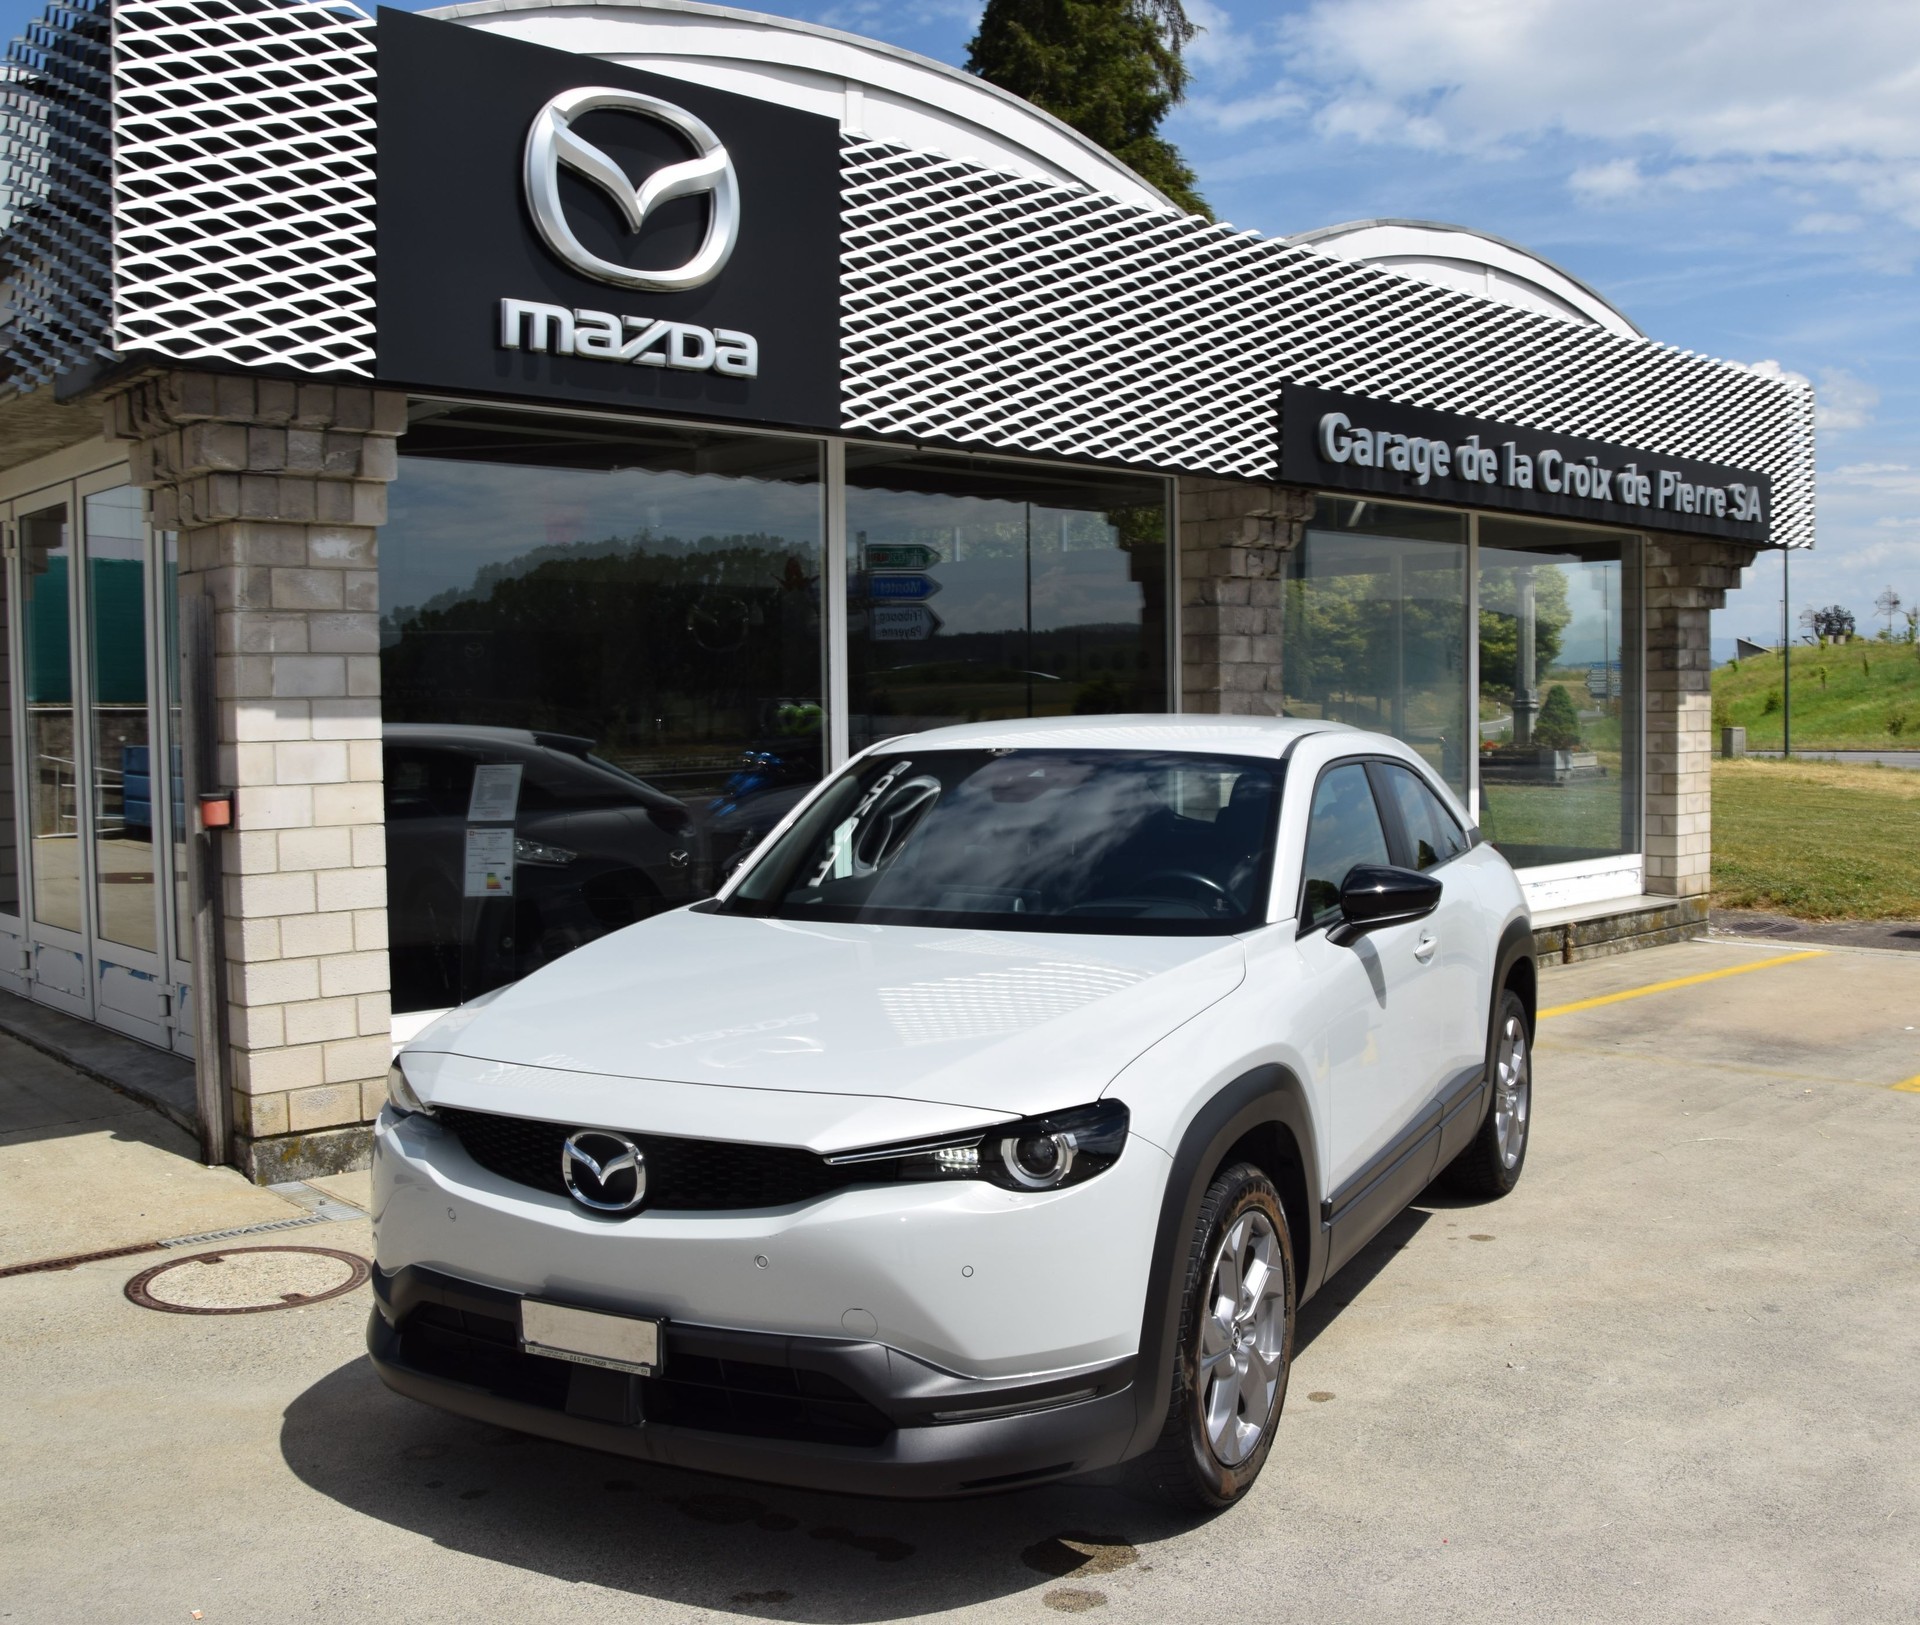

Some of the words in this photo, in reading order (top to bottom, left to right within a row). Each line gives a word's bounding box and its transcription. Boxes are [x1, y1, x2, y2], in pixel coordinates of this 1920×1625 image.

[1319, 412, 1451, 486] Garage
[1455, 435, 1498, 484] de
[1502, 441, 1533, 489] la
[1537, 449, 1613, 501] Croix
[1616, 463, 1651, 507] de
[1654, 469, 1727, 518] Pierre
[1727, 483, 1763, 523] SA
